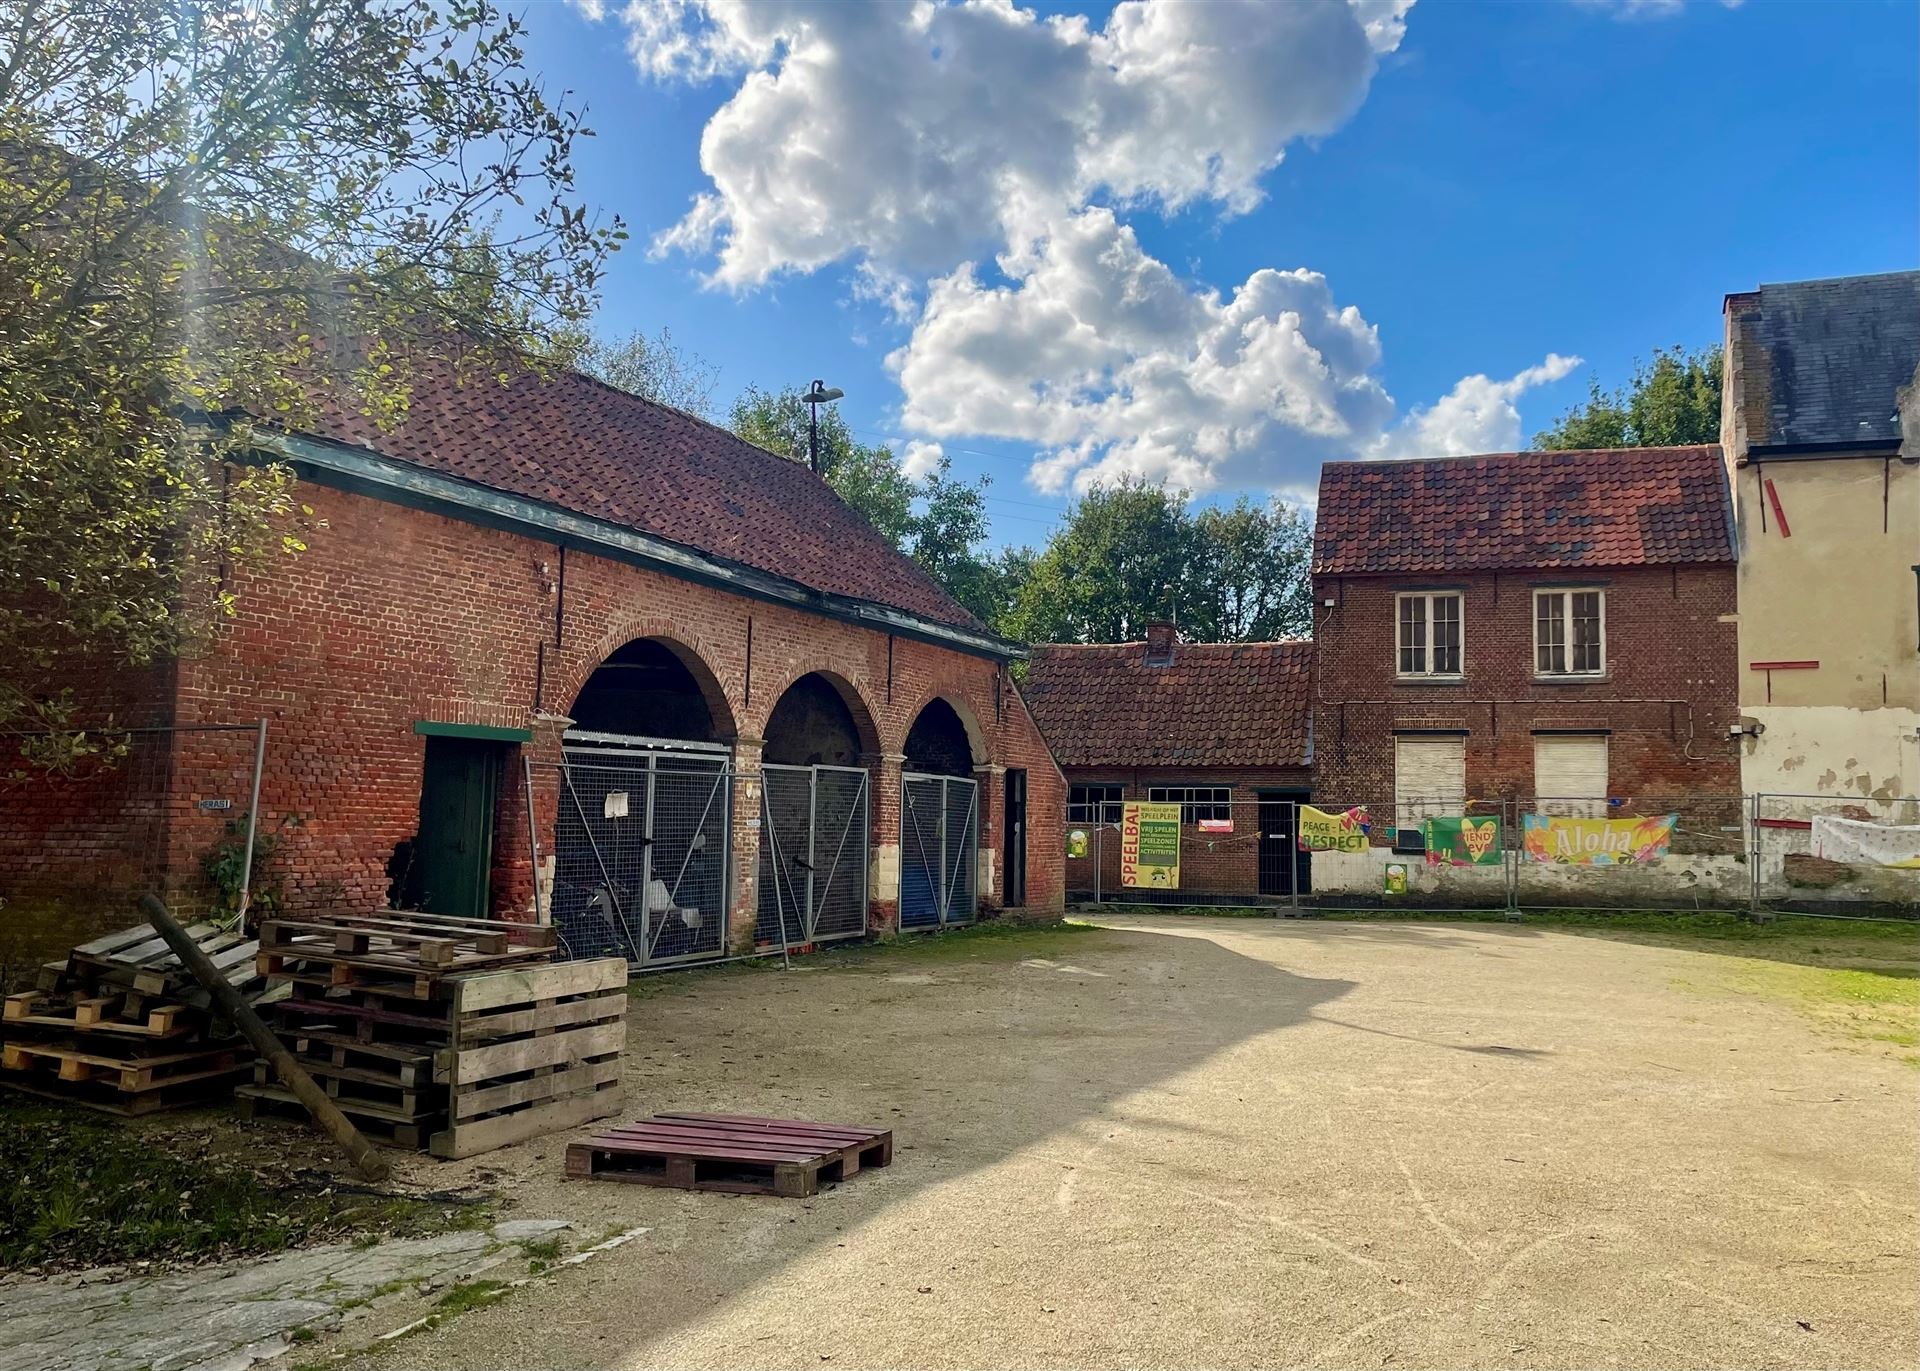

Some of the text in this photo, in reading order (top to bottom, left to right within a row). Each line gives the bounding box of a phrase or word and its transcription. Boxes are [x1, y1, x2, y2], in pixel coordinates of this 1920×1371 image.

[1140, 812, 1179, 820] SPEELPLEIN
[1140, 826, 1154, 834] VRIJ
[1303, 821, 1330, 831] PEACE
[1339, 822, 1359, 832] LV
[1140, 837, 1177, 845] SPEELZONES
[1302, 834, 1365, 848] RESPECT
[1456, 831, 1496, 841] RIENDS
[1555, 823, 1632, 857] Aloha
[1122, 804, 1139, 885] SPEELBAL
